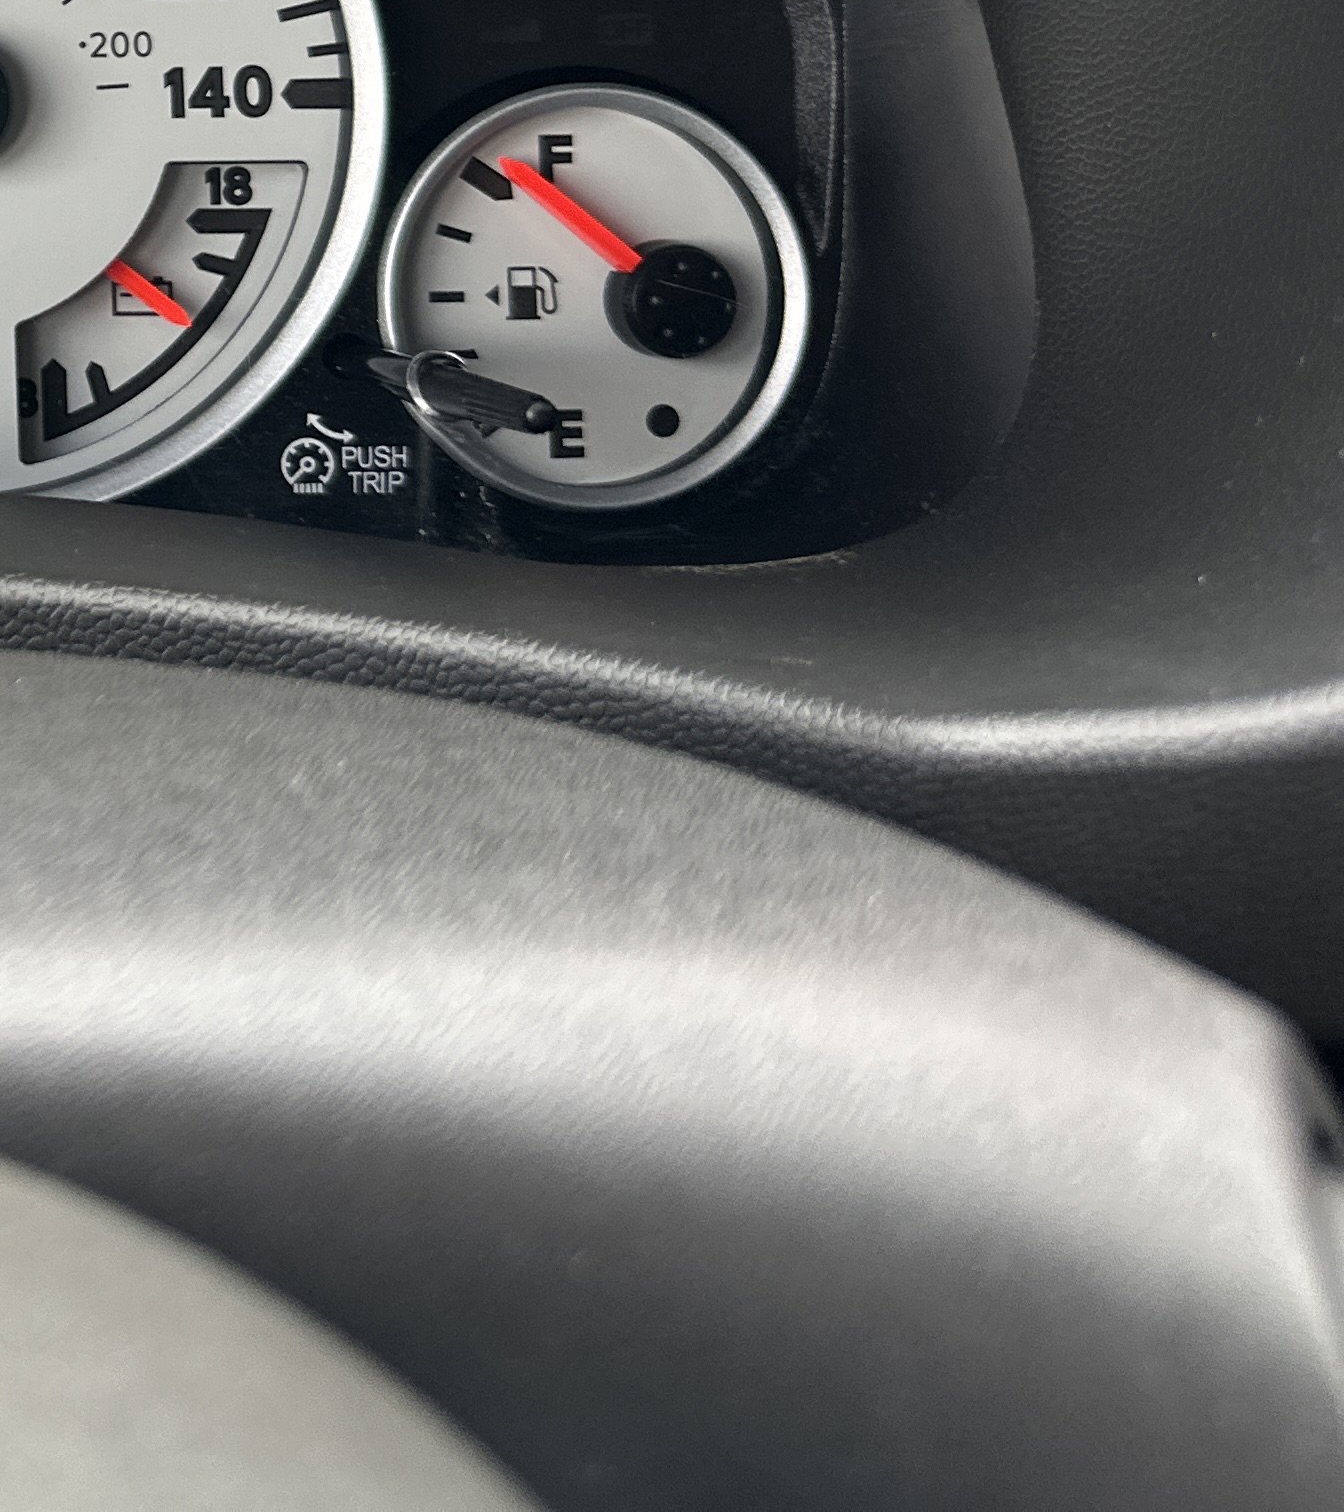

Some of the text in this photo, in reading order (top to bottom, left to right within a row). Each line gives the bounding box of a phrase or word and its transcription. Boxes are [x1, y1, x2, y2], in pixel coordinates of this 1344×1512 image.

[89, 30, 153, 59] 200
[163, 64, 274, 119] 140
[204, 168, 253, 206] 18
[548, 408, 585, 458] E
[341, 445, 408, 469] PUSH
[347, 470, 405, 494] TRIP
